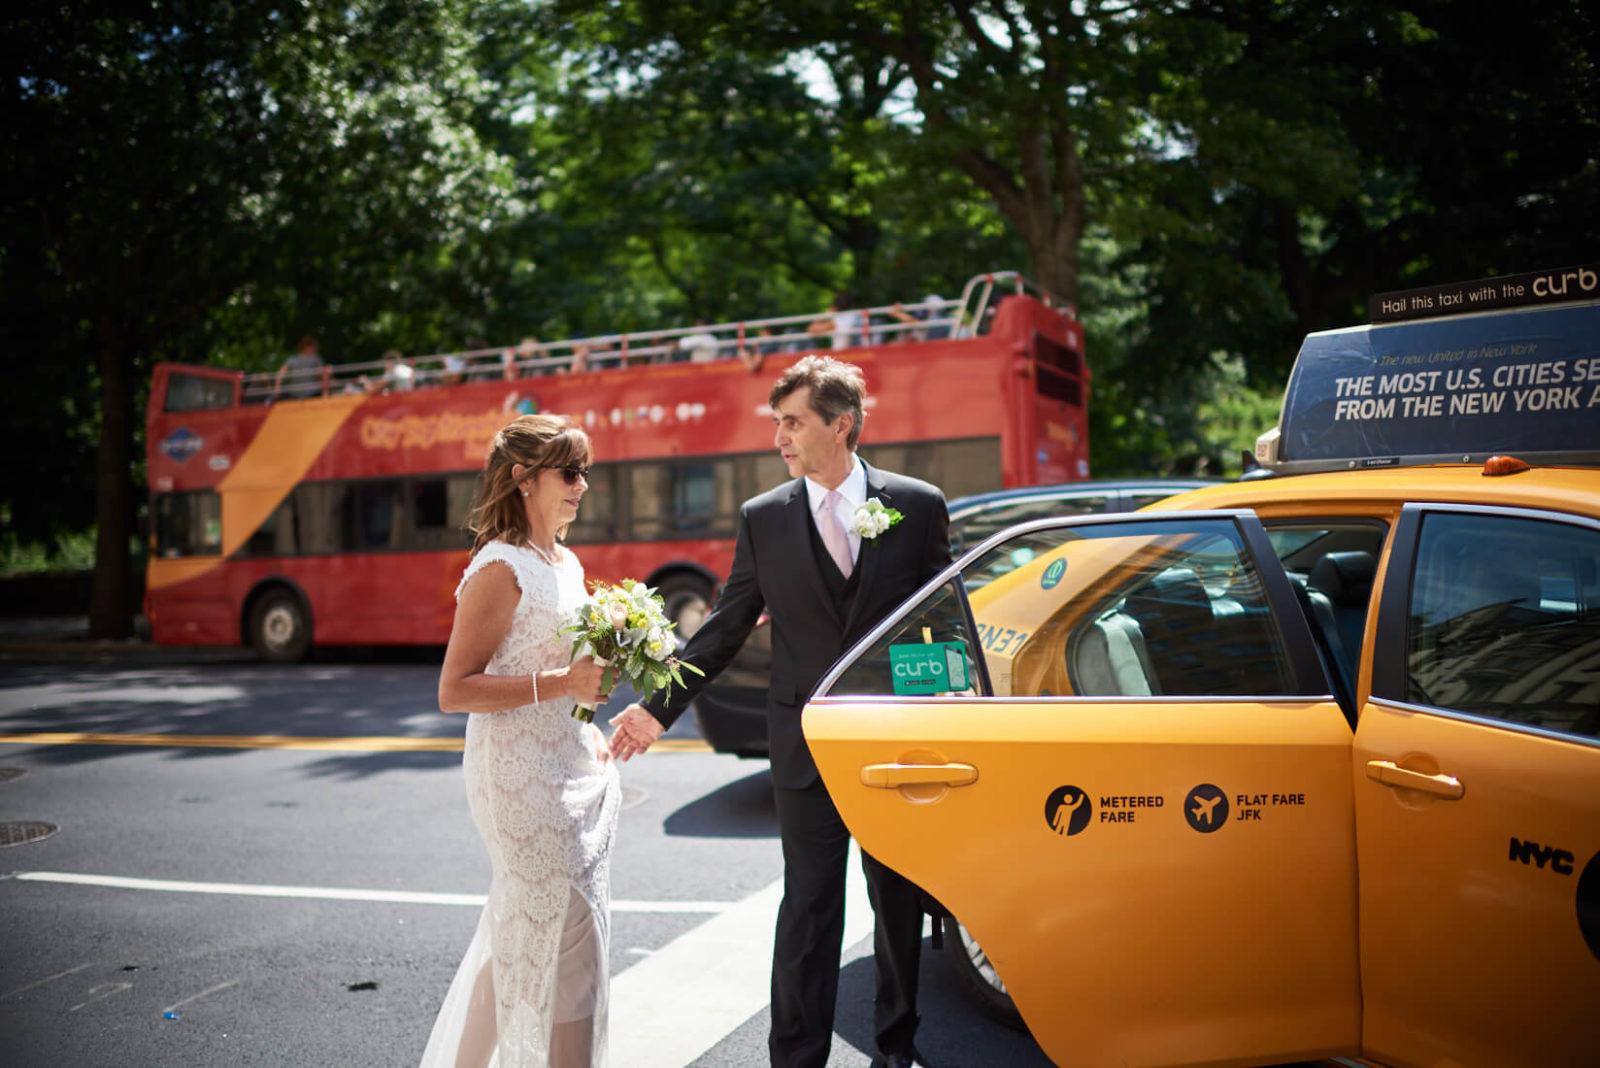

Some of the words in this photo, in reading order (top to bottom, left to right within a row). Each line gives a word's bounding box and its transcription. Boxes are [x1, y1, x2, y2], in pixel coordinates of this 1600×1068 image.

[1382, 299, 1407, 314] Hail
[1412, 296, 1433, 310] this
[1439, 291, 1463, 306] taxi
[1469, 287, 1496, 302] with
[1502, 284, 1525, 298] the
[1532, 268, 1598, 297] curb
[1428, 350, 1465, 365] United
[1480, 345, 1507, 359] New
[1335, 375, 1375, 397] THE
[1378, 371, 1442, 395] MOST
[1445, 367, 1485, 391] U.S.
[1492, 361, 1566, 388] CITIES
[1335, 398, 1396, 421] FROM
[1402, 395, 1444, 418] THE
[1449, 391, 1506, 416] NEW
[1513, 386, 1582, 412] YORK
[894, 659, 943, 677] curb
[1100, 796, 1164, 809] METERED
[1237, 794, 1268, 807] FLAT
[1272, 793, 1306, 806] FARE
[1100, 811, 1136, 823] FARE
[1237, 809, 1262, 821] JFK
[1509, 836, 1575, 876] NYC
